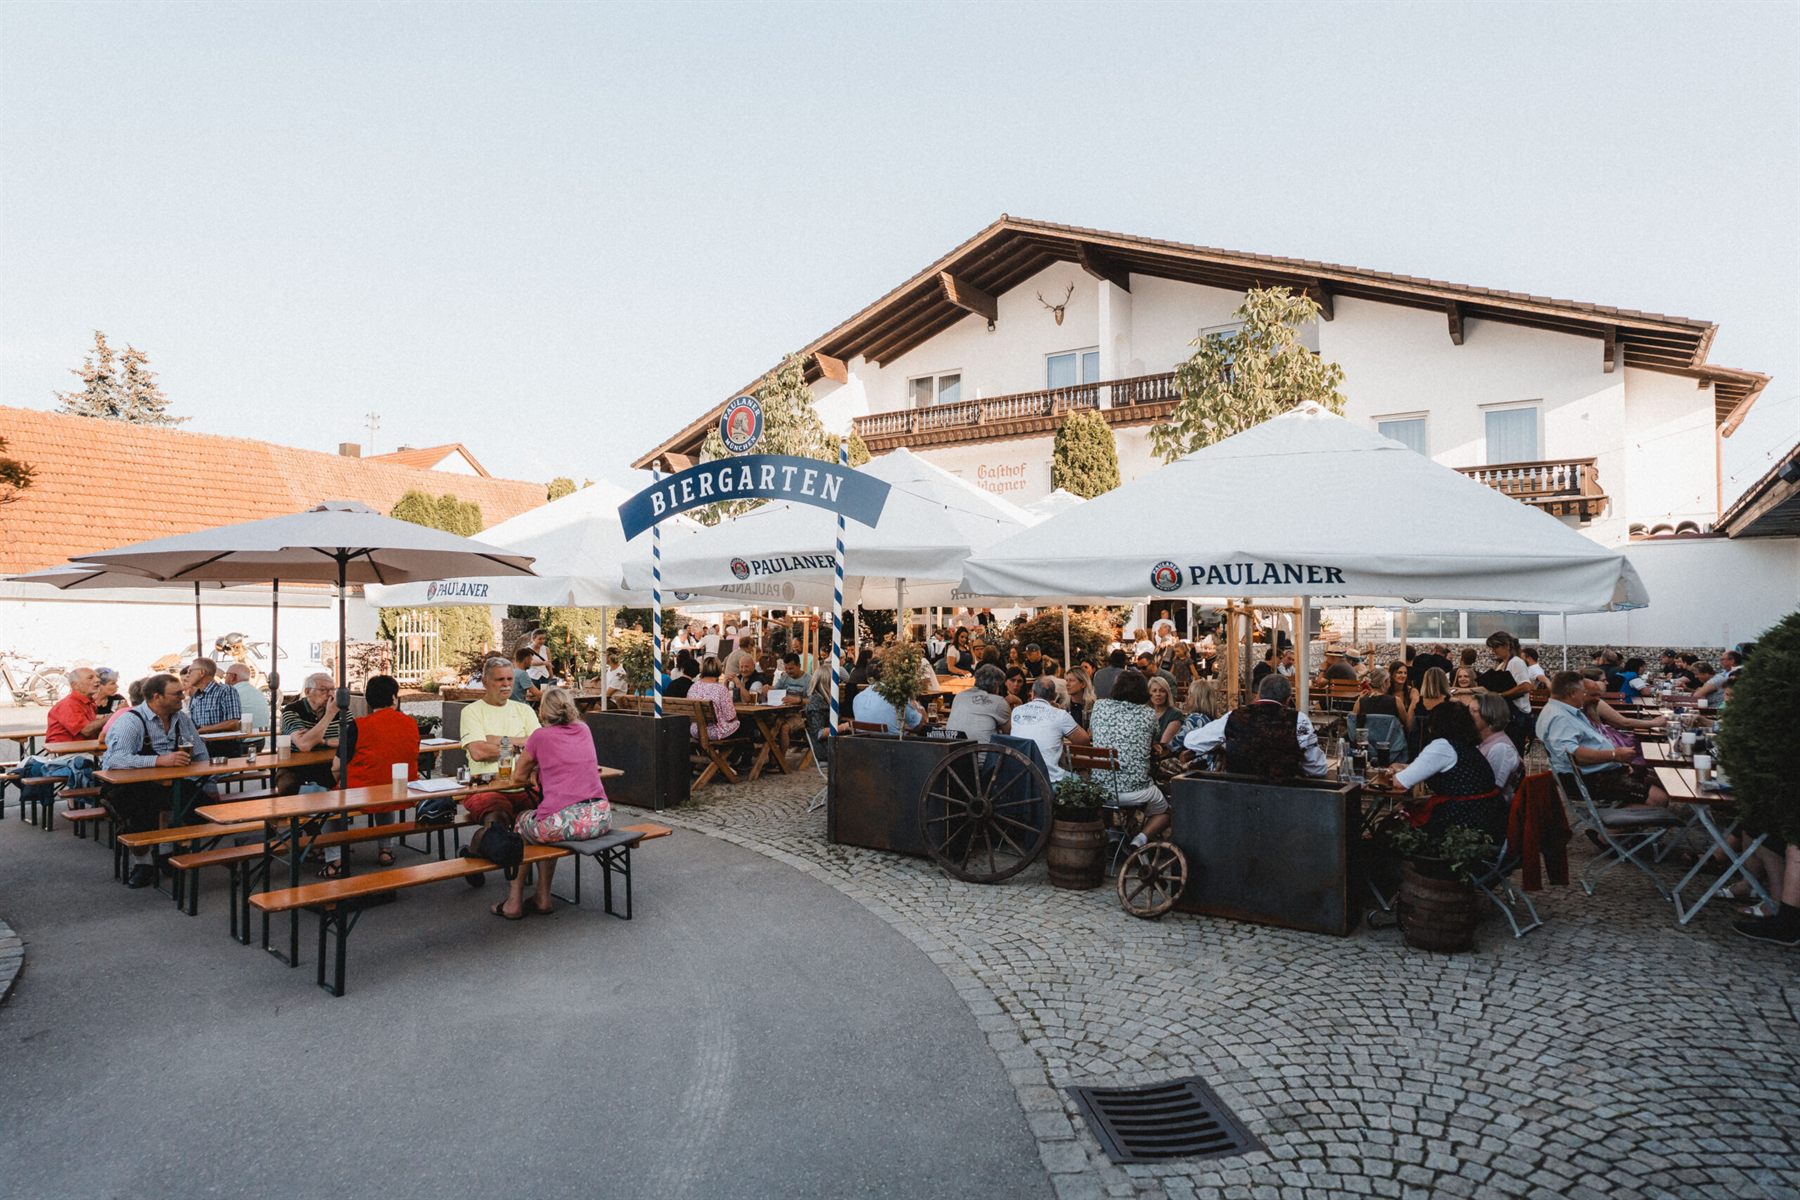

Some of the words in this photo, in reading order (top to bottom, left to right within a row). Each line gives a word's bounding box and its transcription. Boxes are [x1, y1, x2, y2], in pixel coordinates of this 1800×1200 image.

[723, 398, 761, 420] PAULANER
[725, 436, 756, 451] MÜNCHEN
[977, 462, 1027, 479] Gasthof
[650, 464, 844, 517] BIERGARTEN
[750, 555, 837, 575] PAULANER
[1188, 562, 1346, 586] PAULANER
[436, 582, 489, 598] PAULANER
[312, 643, 320, 659] P
